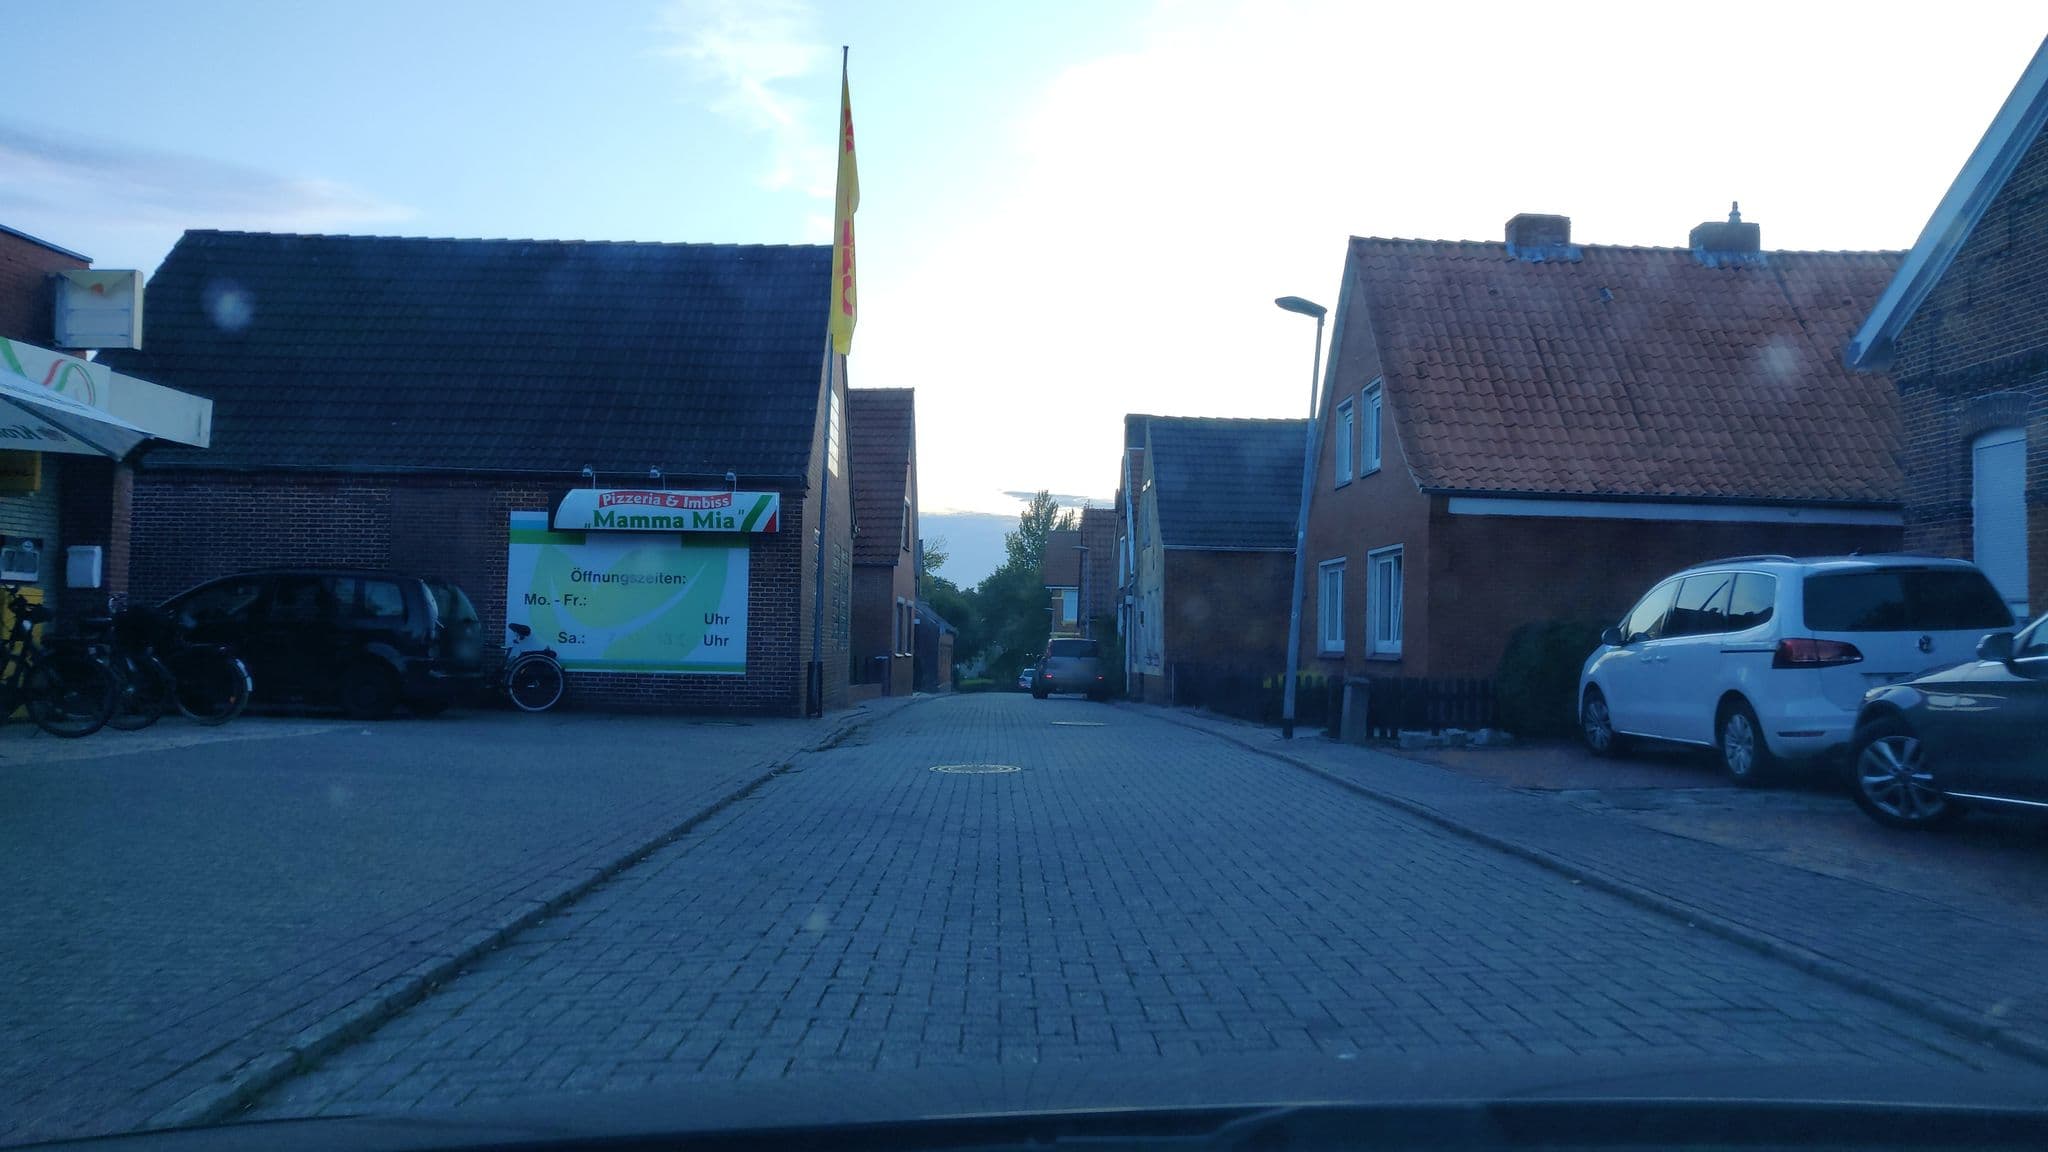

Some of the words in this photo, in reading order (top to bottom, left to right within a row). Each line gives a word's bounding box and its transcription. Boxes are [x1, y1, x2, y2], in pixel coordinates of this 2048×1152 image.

[602, 492, 661, 506] Pizzeria
[665, 495, 679, 507] &
[683, 495, 730, 509] Imbiss
[570, 567, 687, 586] Öffnungszeiten:
[524, 593, 551, 607] Mo.
[563, 593, 588, 607] Fr.:
[704, 612, 731, 626] Uhr
[557, 631, 586, 645] Sa.:
[703, 633, 730, 647] Uhr
